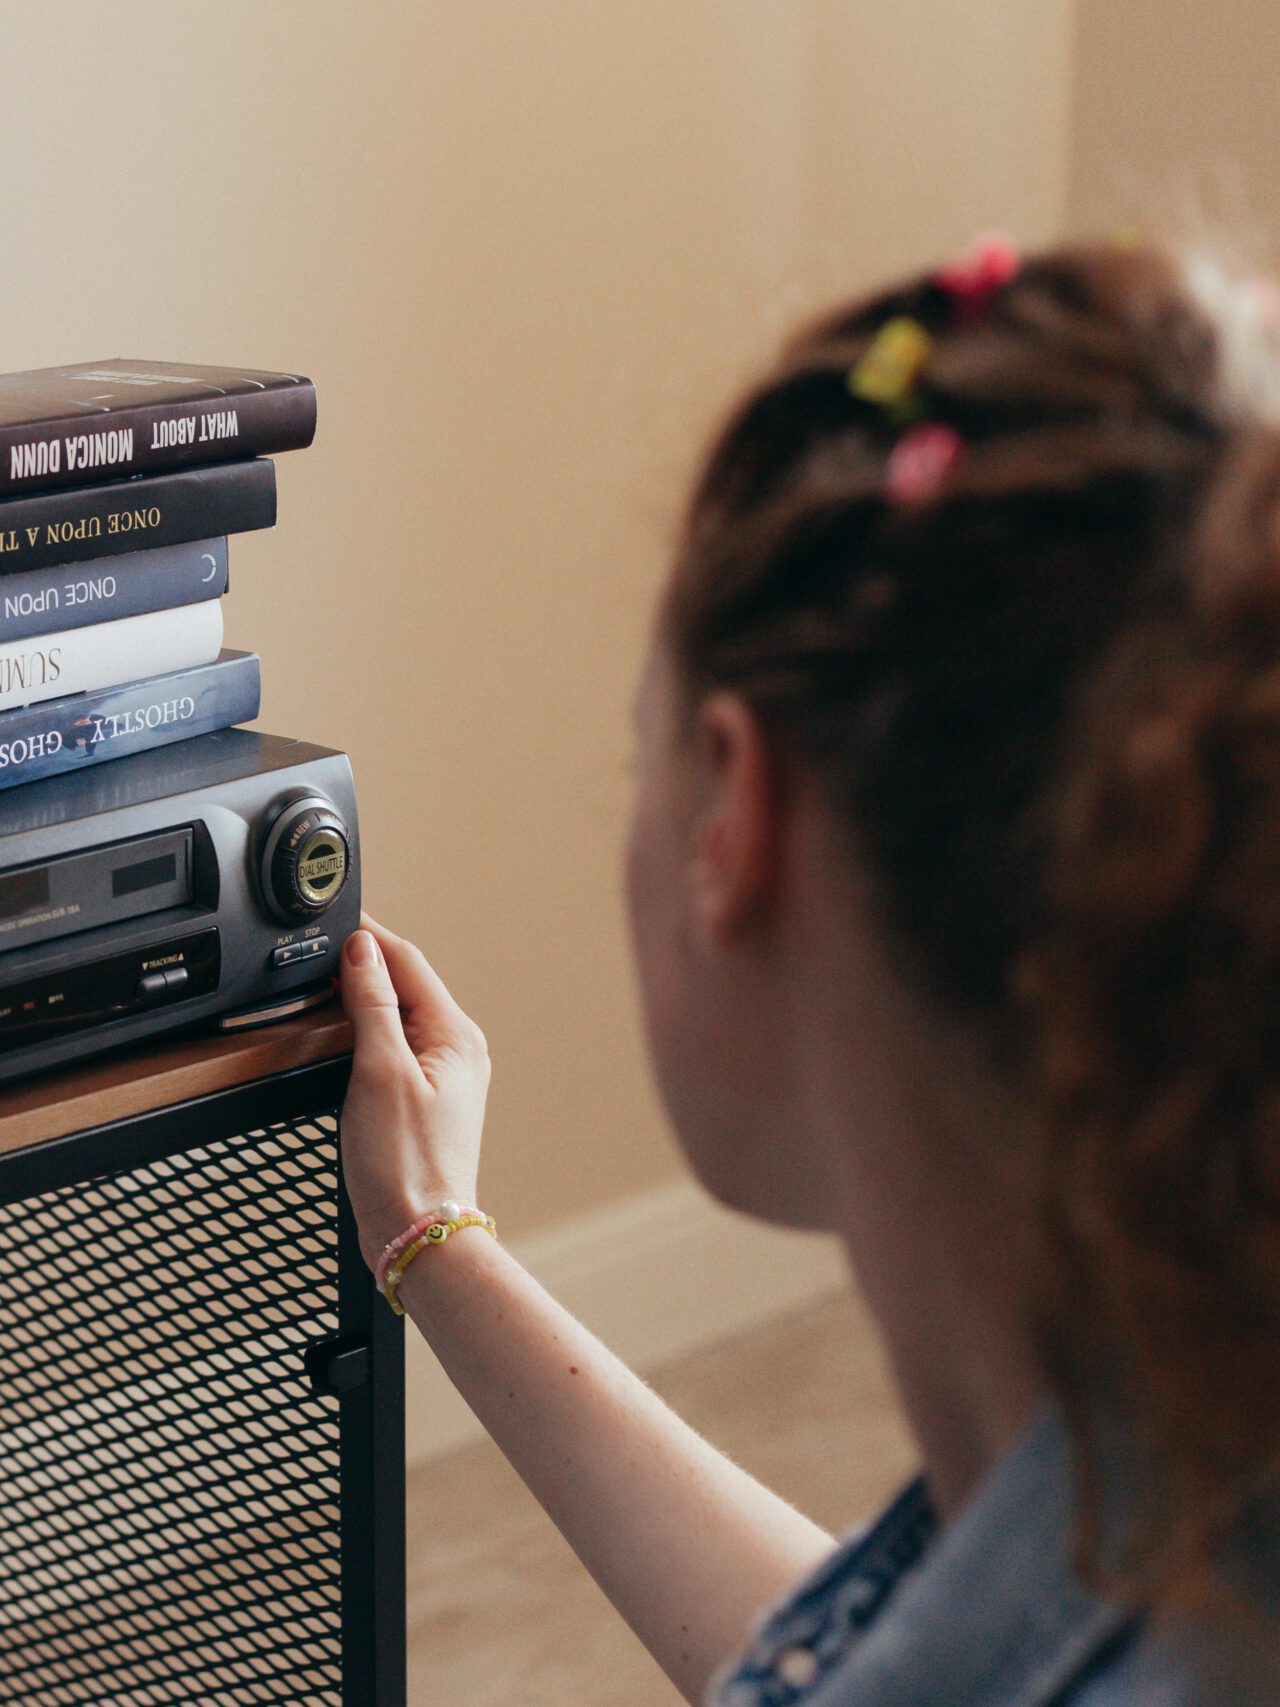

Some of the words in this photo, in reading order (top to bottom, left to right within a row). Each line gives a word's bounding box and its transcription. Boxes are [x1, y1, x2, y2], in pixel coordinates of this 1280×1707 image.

[150, 416, 196, 450] ABOUT
[198, 410, 239, 442] WHAT
[10, 439, 61, 480] DUNN
[65, 428, 134, 471] MONICA
[46, 516, 102, 545] UPON
[107, 507, 161, 534] ONCE
[26, 527, 39, 547] A
[4, 587, 59, 618] UPON
[65, 576, 116, 606] ONCE
[89, 696, 195, 744] GHOSTLY
[296, 819, 311, 835] REW
[299, 863, 315, 879] DIAL
[316, 855, 344, 875] SHUTTLE
[277, 934, 294, 946] PLAY
[305, 926, 321, 938] STOP
[148, 954, 178, 969] TRACKING
